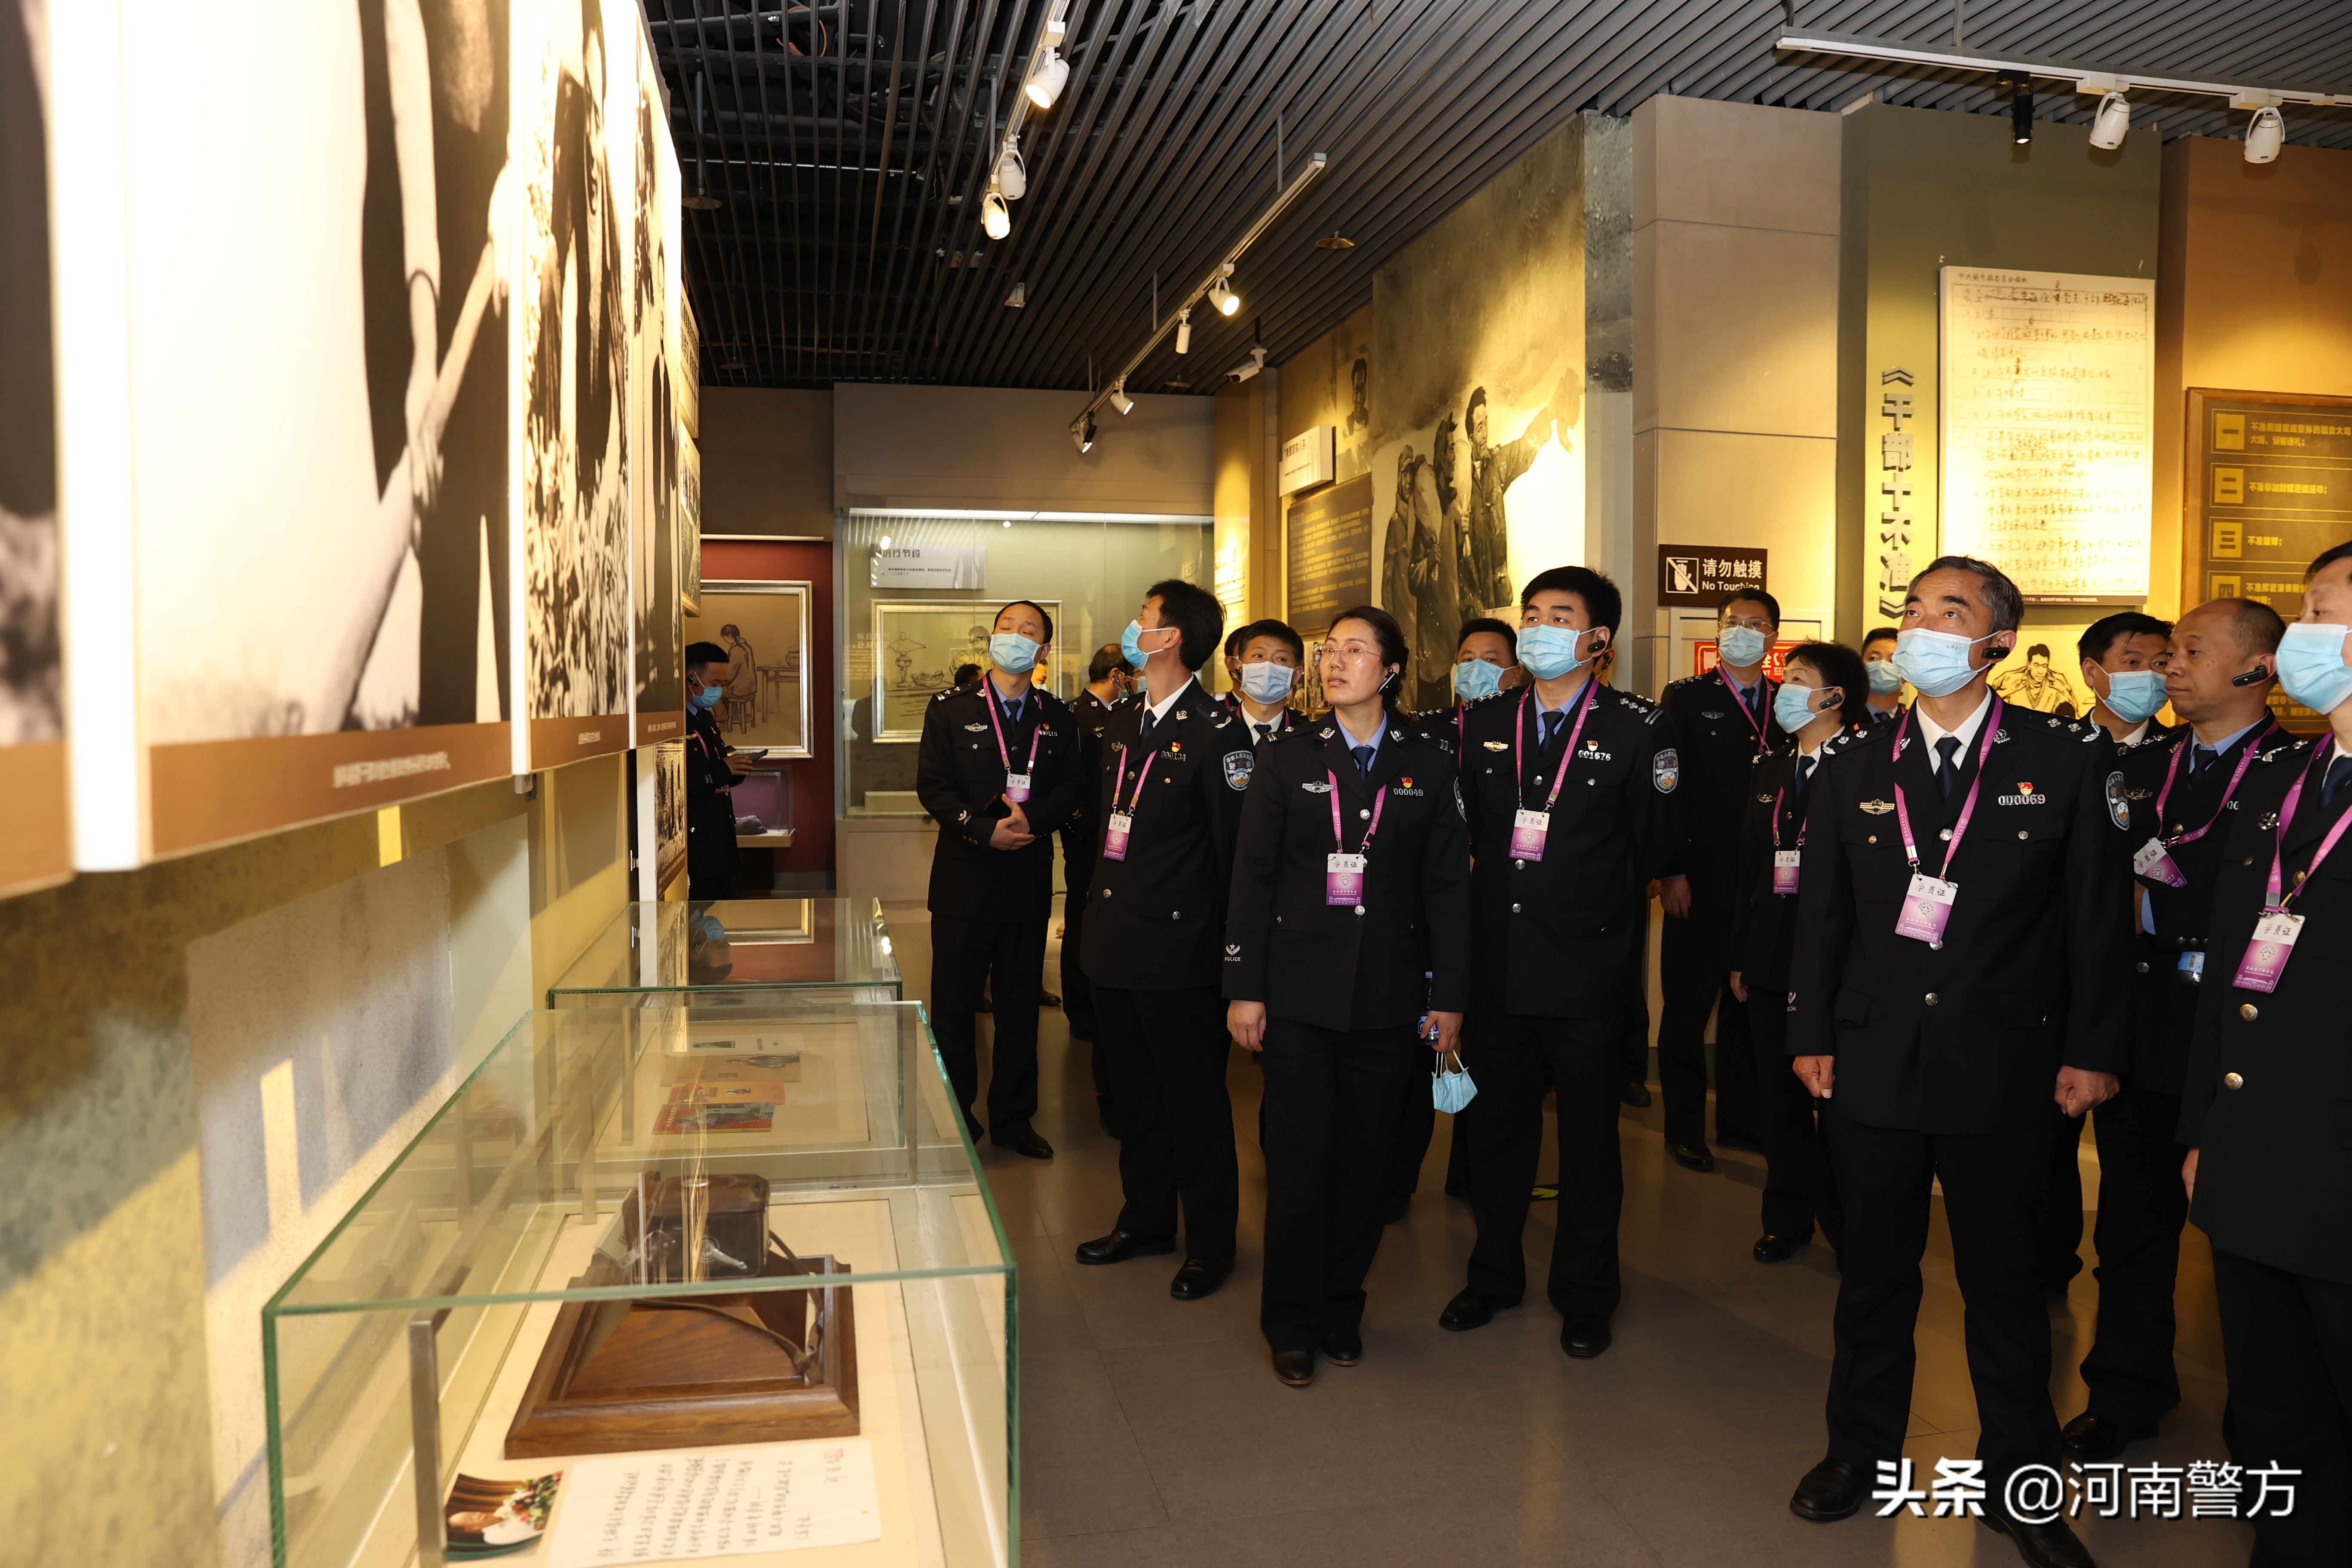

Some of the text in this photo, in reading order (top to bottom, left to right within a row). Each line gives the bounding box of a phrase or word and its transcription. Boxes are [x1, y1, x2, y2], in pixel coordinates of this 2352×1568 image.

[2220, 477, 2238, 494] 二
[1879, 366, 1914, 619] 《干部十不准》
[2219, 530, 2236, 549] 三
[1702, 557, 1763, 579] 请勿触摸
[1702, 580, 1716, 591] No
[1161, 750, 1186, 762] 000134
[1578, 750, 1611, 761] 001676
[1393, 788, 1424, 796] 000049
[1998, 794, 2046, 805] 000069
[1521, 816, 1542, 825] 学员证
[1916, 882, 1946, 897] 学员证
[2263, 923, 2292, 936] 学员证
